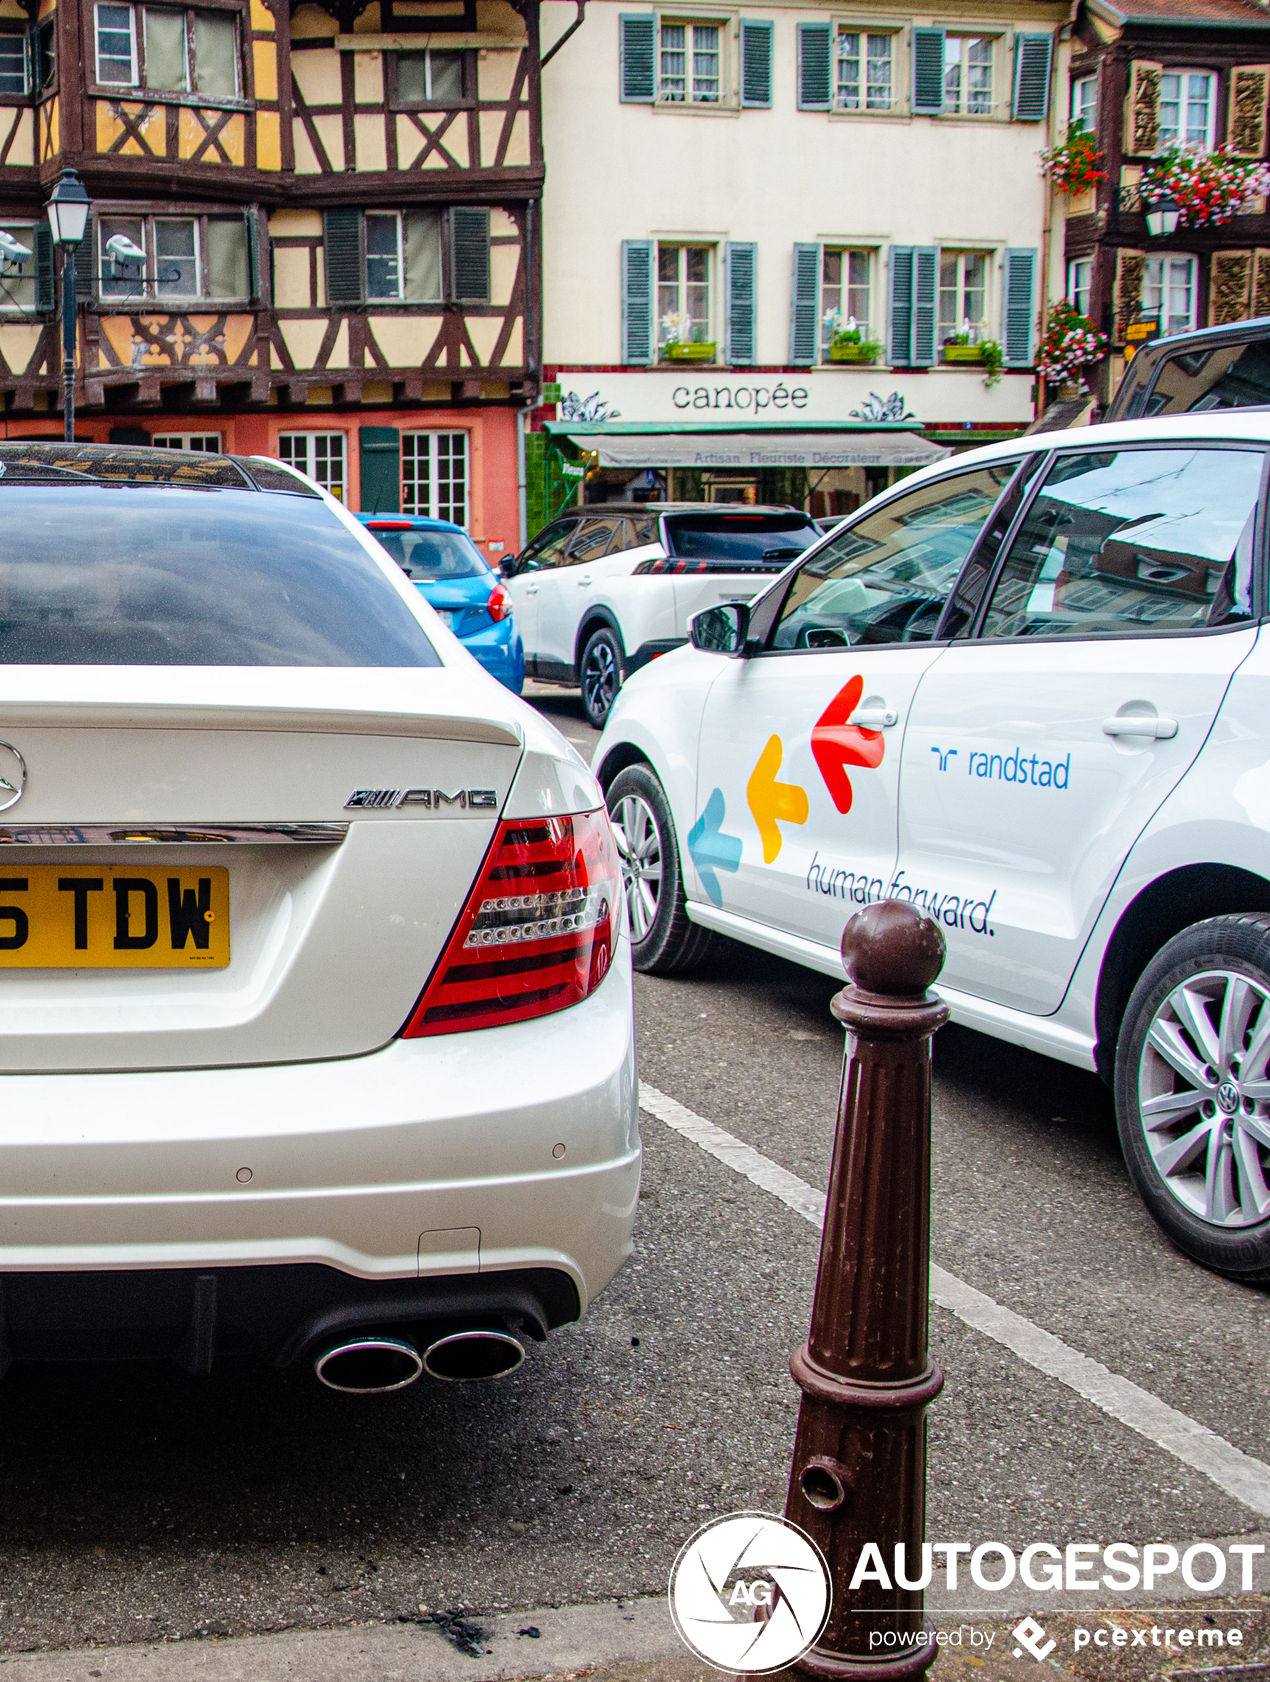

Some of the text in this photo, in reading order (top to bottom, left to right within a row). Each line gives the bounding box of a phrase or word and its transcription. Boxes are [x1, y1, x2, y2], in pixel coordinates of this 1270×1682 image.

[672, 382, 808, 414] canopée
[694, 452, 740, 463] Artisan
[750, 451, 805, 463] Fleuriste
[812, 451, 881, 463] Décorateur
[968, 746, 1071, 790] randstad
[396, 788, 498, 808] AMG
[806, 851, 883, 905] human
[57, 877, 212, 950] TDW
